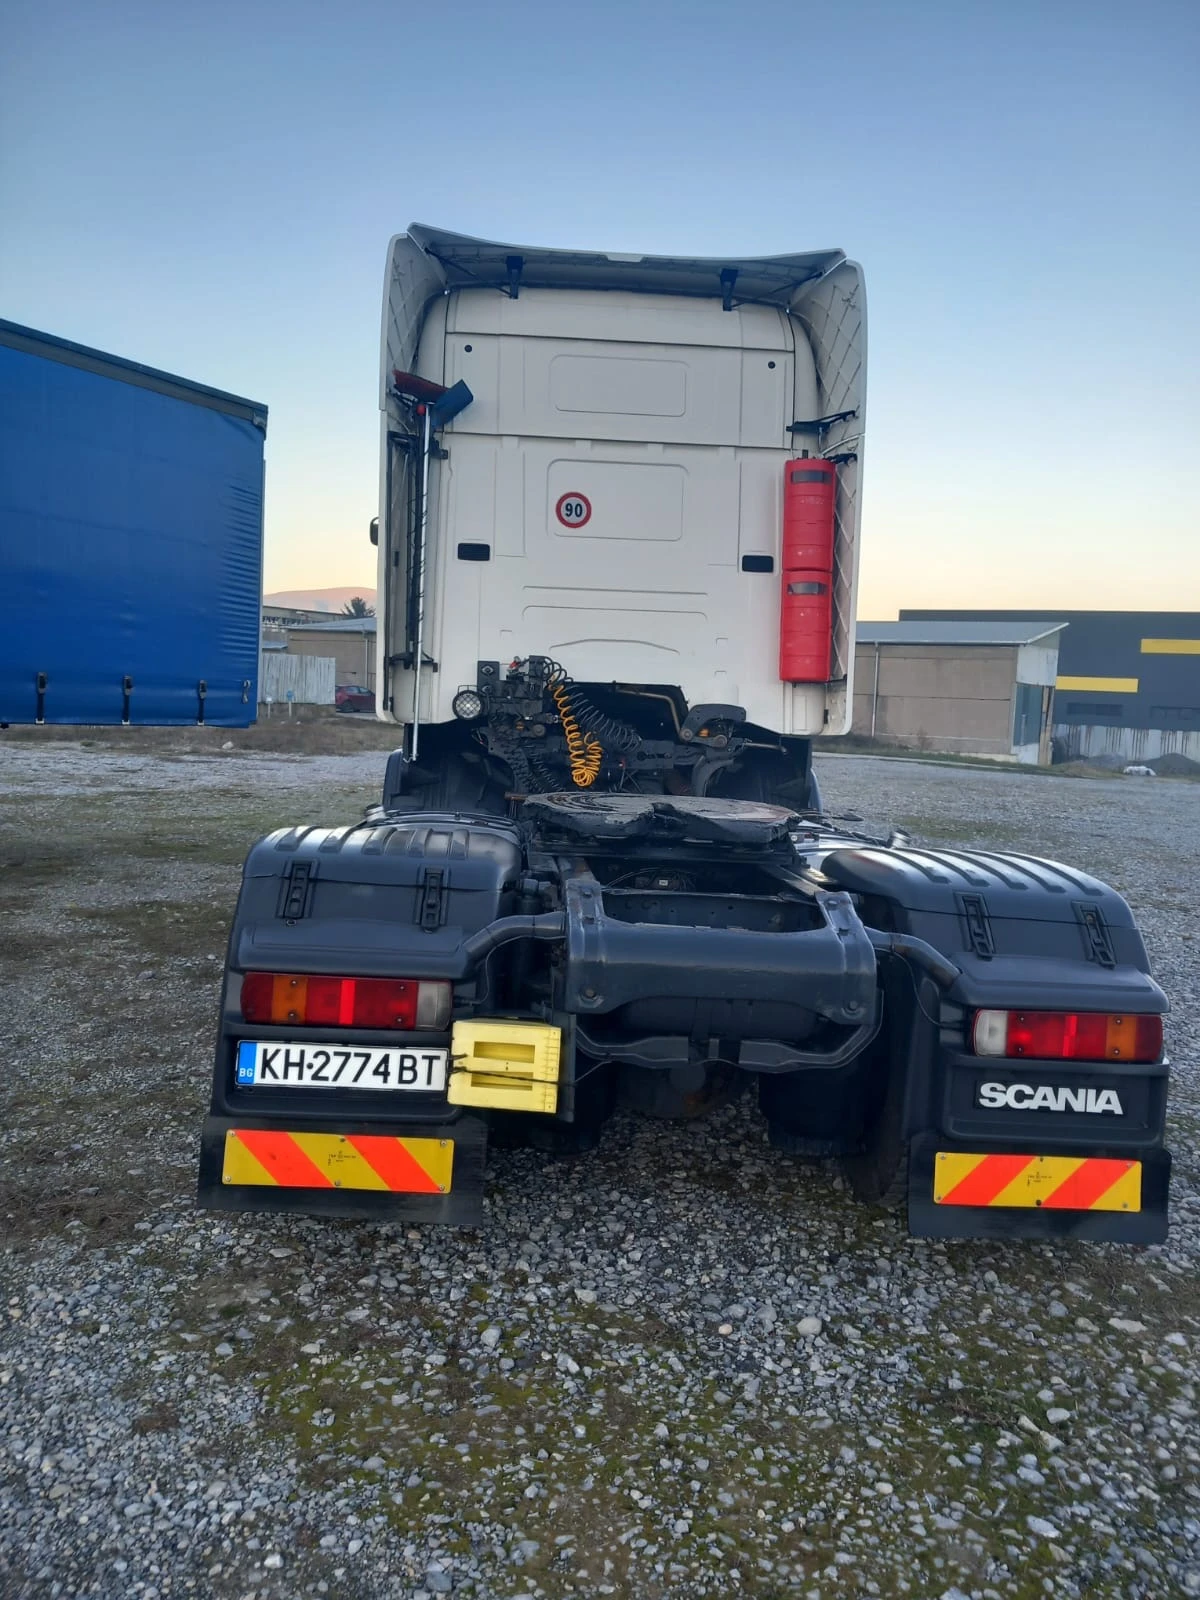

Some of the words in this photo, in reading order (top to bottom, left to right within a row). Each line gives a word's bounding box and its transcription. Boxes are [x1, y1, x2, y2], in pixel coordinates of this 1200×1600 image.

[565, 502, 583, 518] 90
[239, 1067, 254, 1078] BG
[979, 1082, 1124, 1115] SCANIA
